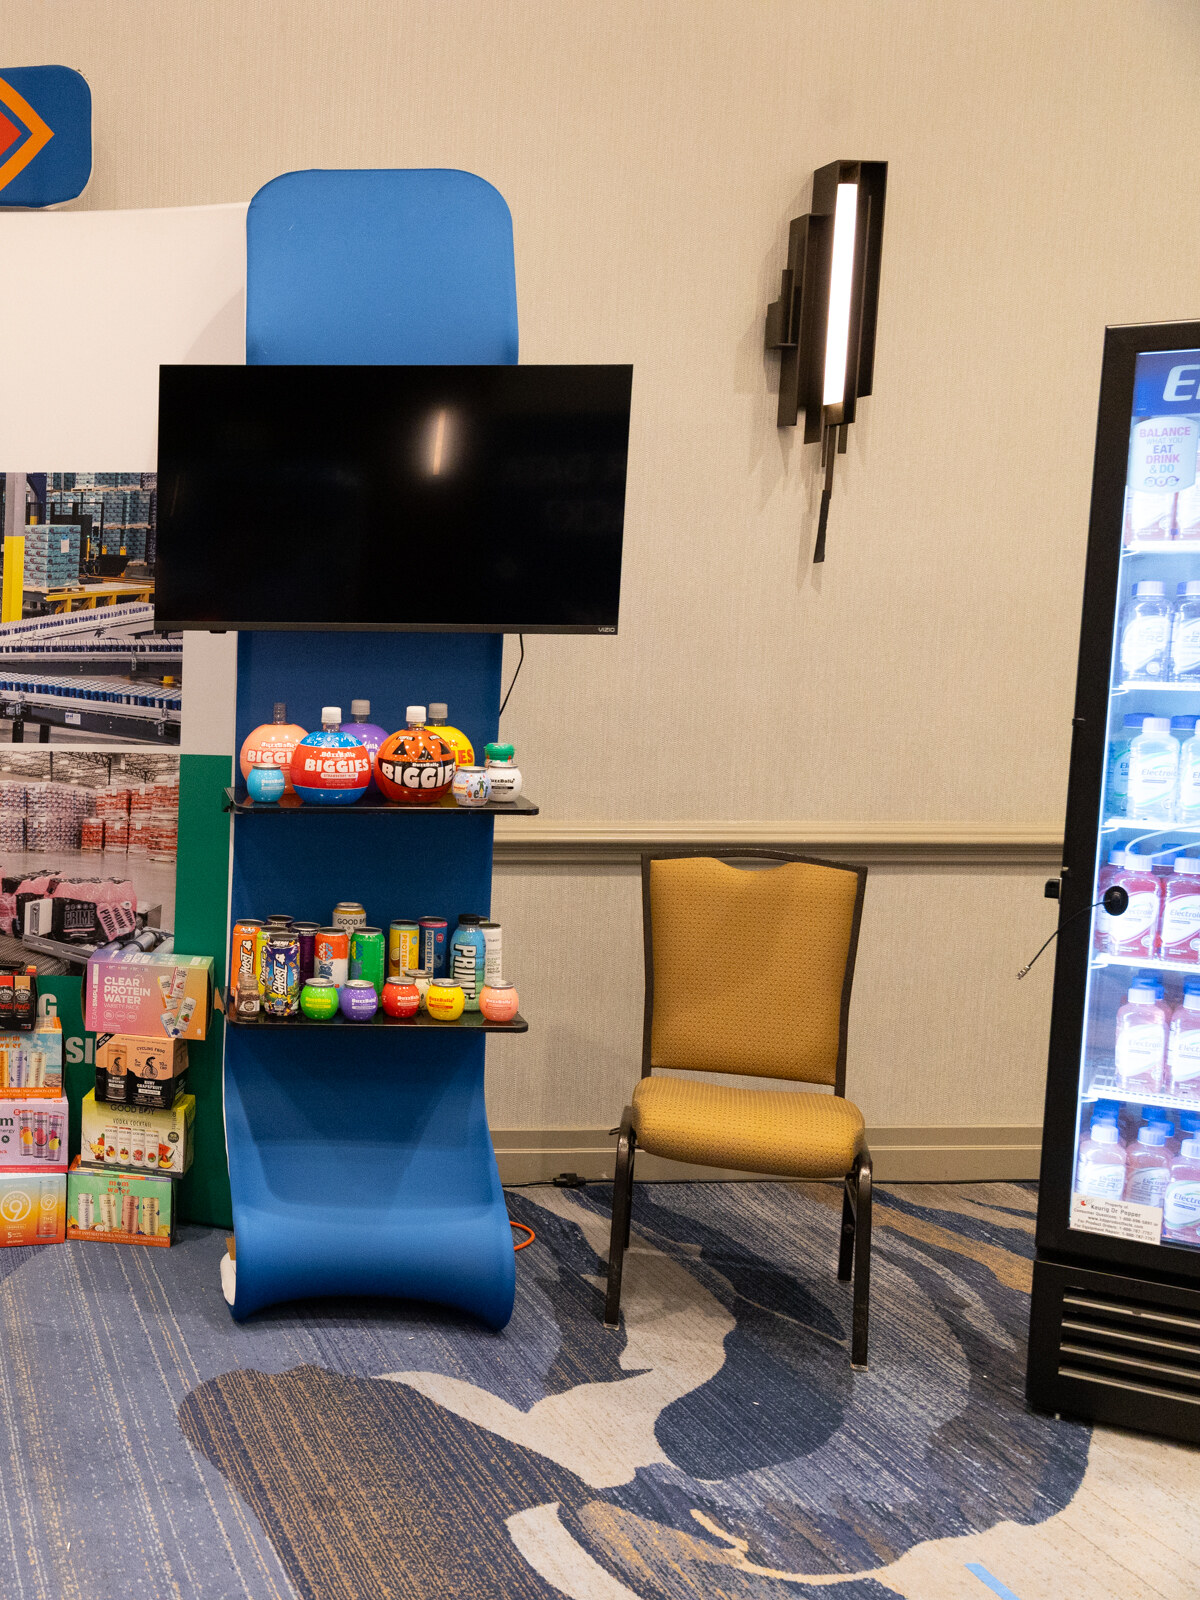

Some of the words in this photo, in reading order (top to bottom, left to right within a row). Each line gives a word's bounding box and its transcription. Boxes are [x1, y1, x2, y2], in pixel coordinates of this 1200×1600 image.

[1139, 427, 1191, 438] BALANCE
[1153, 445, 1173, 454] EAT
[1145, 454, 1180, 464] DRINK
[1159, 464, 1175, 473] DO
[304, 758, 369, 773] BIGGIES
[381, 761, 456, 789] BIGGIE
[104, 976, 140, 987] CLEAR
[271, 961, 288, 995] GHOST
[104, 985, 151, 997] PROTEIN
[104, 993, 141, 1005] WATER
[110, 1103, 137, 1112] GOOD
[1173, 1193, 1200, 1205] Electro
